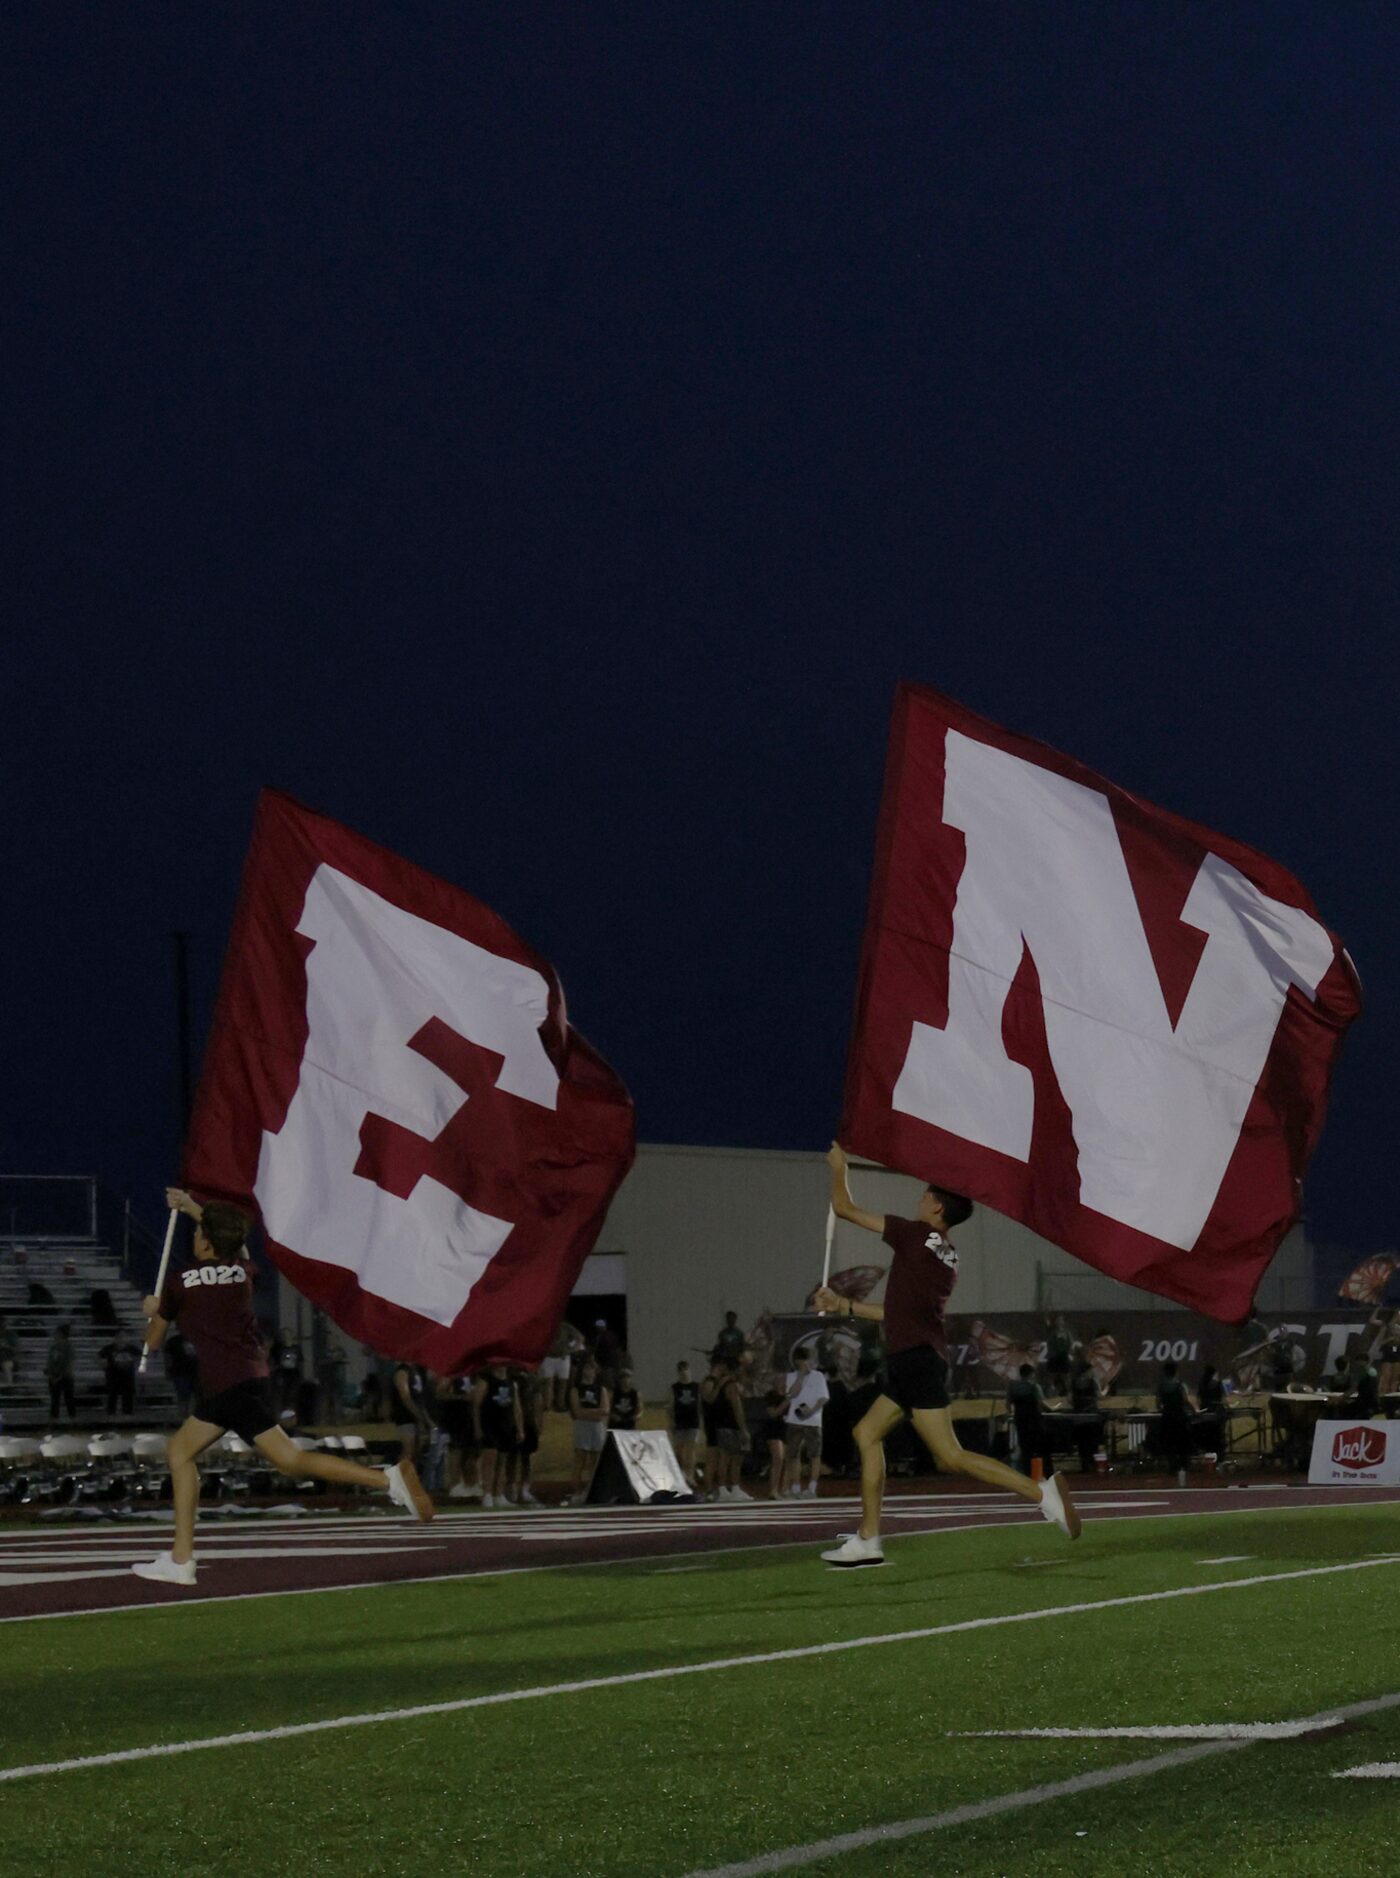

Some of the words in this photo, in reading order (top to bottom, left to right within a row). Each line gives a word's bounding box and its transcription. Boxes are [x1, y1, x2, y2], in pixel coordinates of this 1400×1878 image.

[892, 728, 1338, 1252] N
[255, 862, 562, 1328] E
[181, 1265, 247, 1289] 2023
[1137, 1339, 1198, 1362] 2001
[1332, 1431, 1385, 1463] Jack
